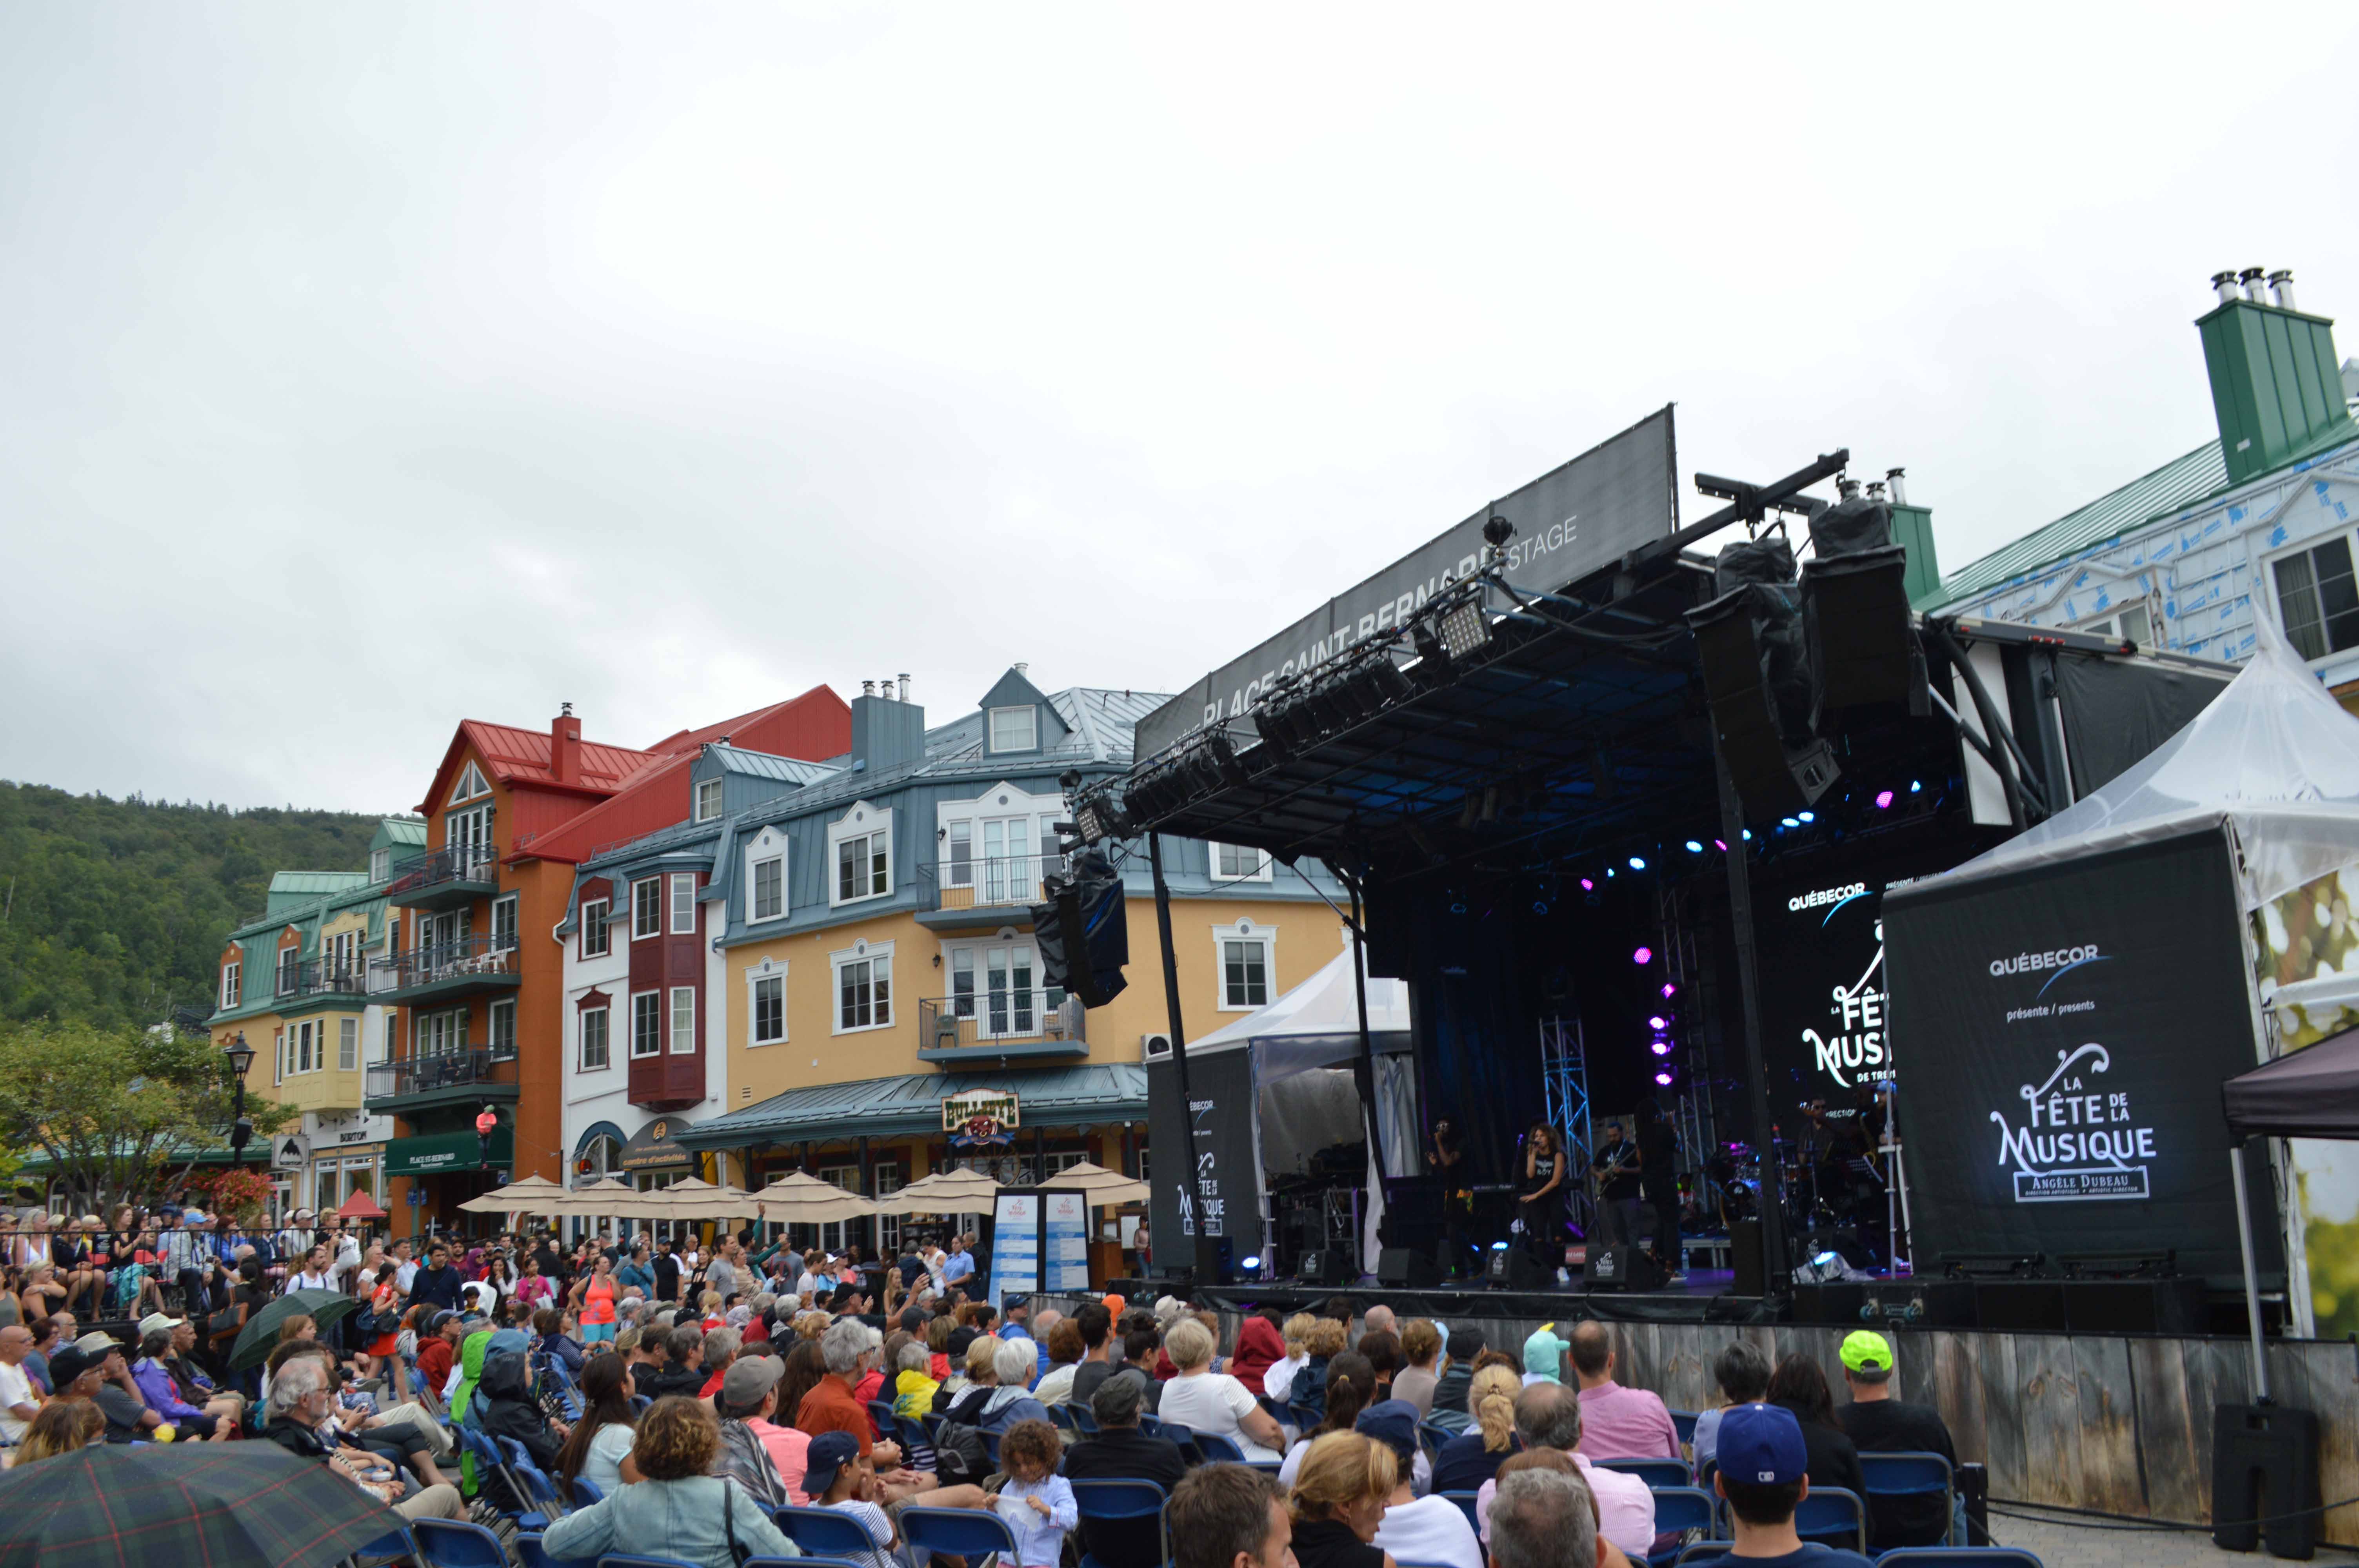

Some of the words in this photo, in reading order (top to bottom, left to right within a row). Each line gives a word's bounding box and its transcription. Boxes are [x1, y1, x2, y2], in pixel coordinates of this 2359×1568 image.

[1508, 514, 1577, 571] STAGE
[1788, 882, 1865, 911] QUÉBECOR
[1990, 944, 2098, 976] QUÉBECOR
[1831, 1006, 1840, 1015] LA
[2007, 1004, 2048, 1023] présente
[2058, 1000, 2095, 1016] presents
[1857, 1072, 1870, 1083] DE
[2063, 1077, 2082, 1091] LA
[2020, 1083, 2102, 1128] FÊTE
[2109, 1093, 2128, 1107] DE
[2111, 1107, 2130, 1122] LA
[340, 1131, 367, 1142] BURTON
[1990, 1112, 2157, 1172] MUSIQUE
[623, 1157, 647, 1166] centre
[648, 1153, 687, 1164] d'activités
[2032, 1175, 2076, 1190] ANGÈLE
[2081, 1174, 2128, 1188] DUBEAU
